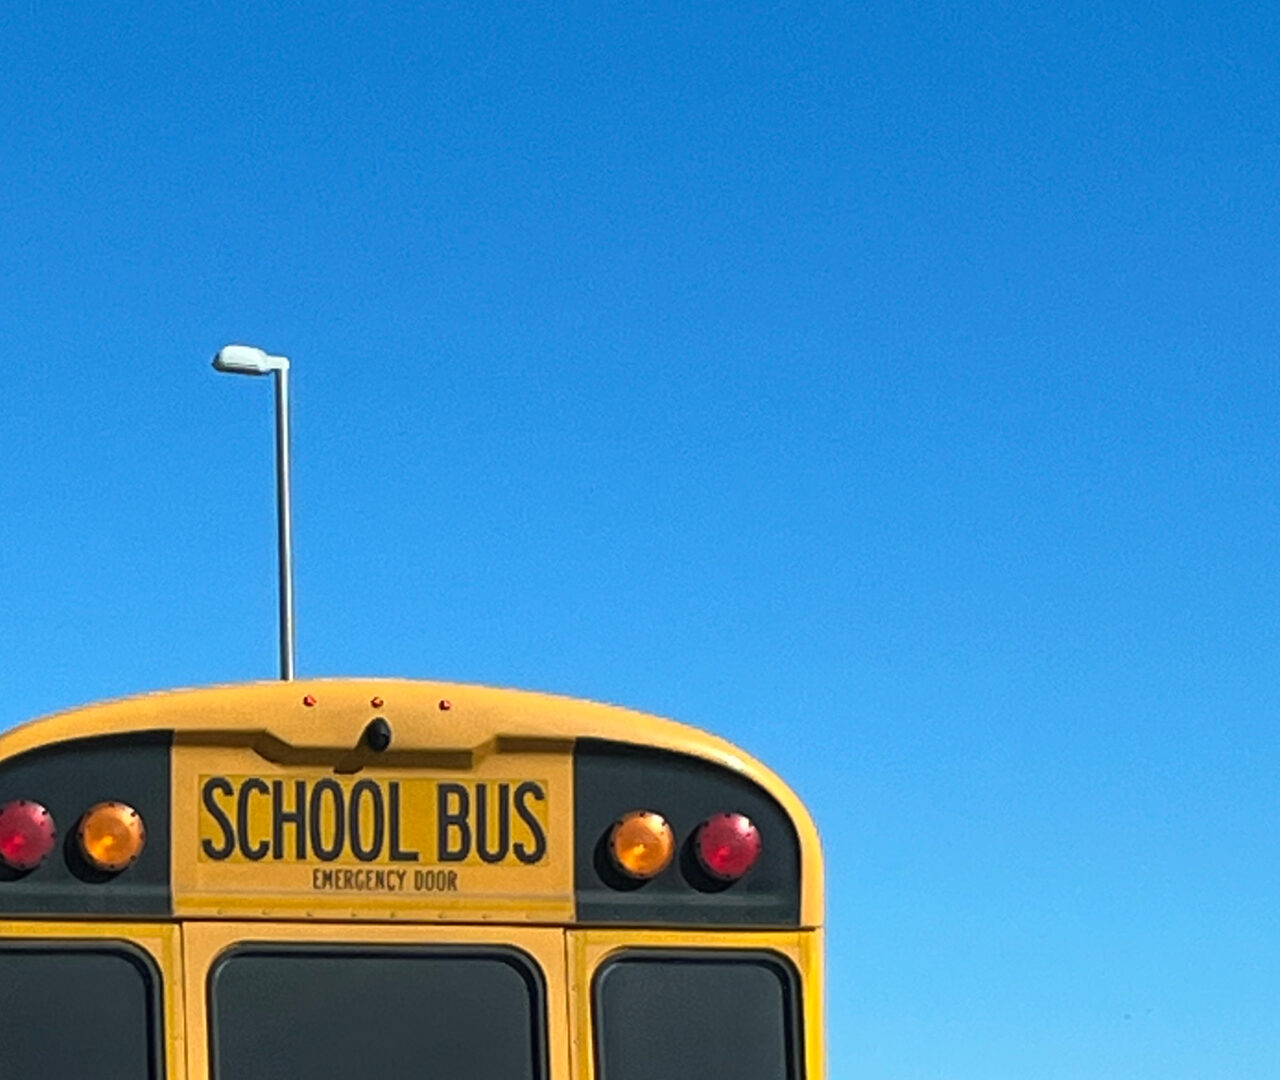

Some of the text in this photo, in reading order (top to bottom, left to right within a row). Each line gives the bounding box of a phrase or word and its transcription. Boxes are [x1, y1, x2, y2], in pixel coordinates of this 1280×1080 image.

[201, 777, 547, 865] SCHOOL BUS
[312, 868, 458, 892] EMERGENCY DOOR
